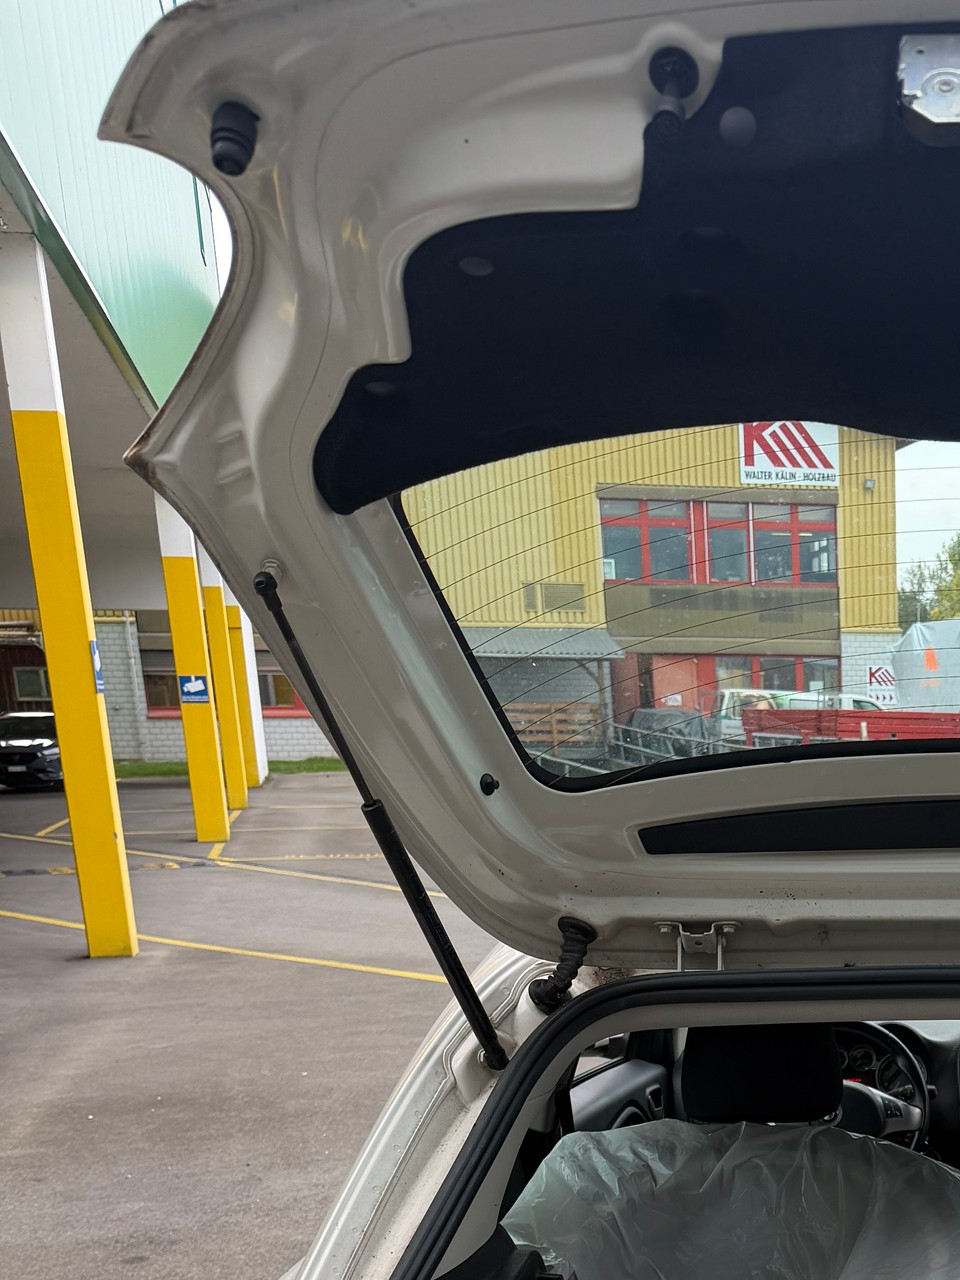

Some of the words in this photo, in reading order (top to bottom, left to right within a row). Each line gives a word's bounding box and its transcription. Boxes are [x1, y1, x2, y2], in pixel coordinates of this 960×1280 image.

[744, 470, 773, 480] WALTER
[775, 470, 797, 481] KÄLIN
[803, 472, 837, 482] HOLZBAU
